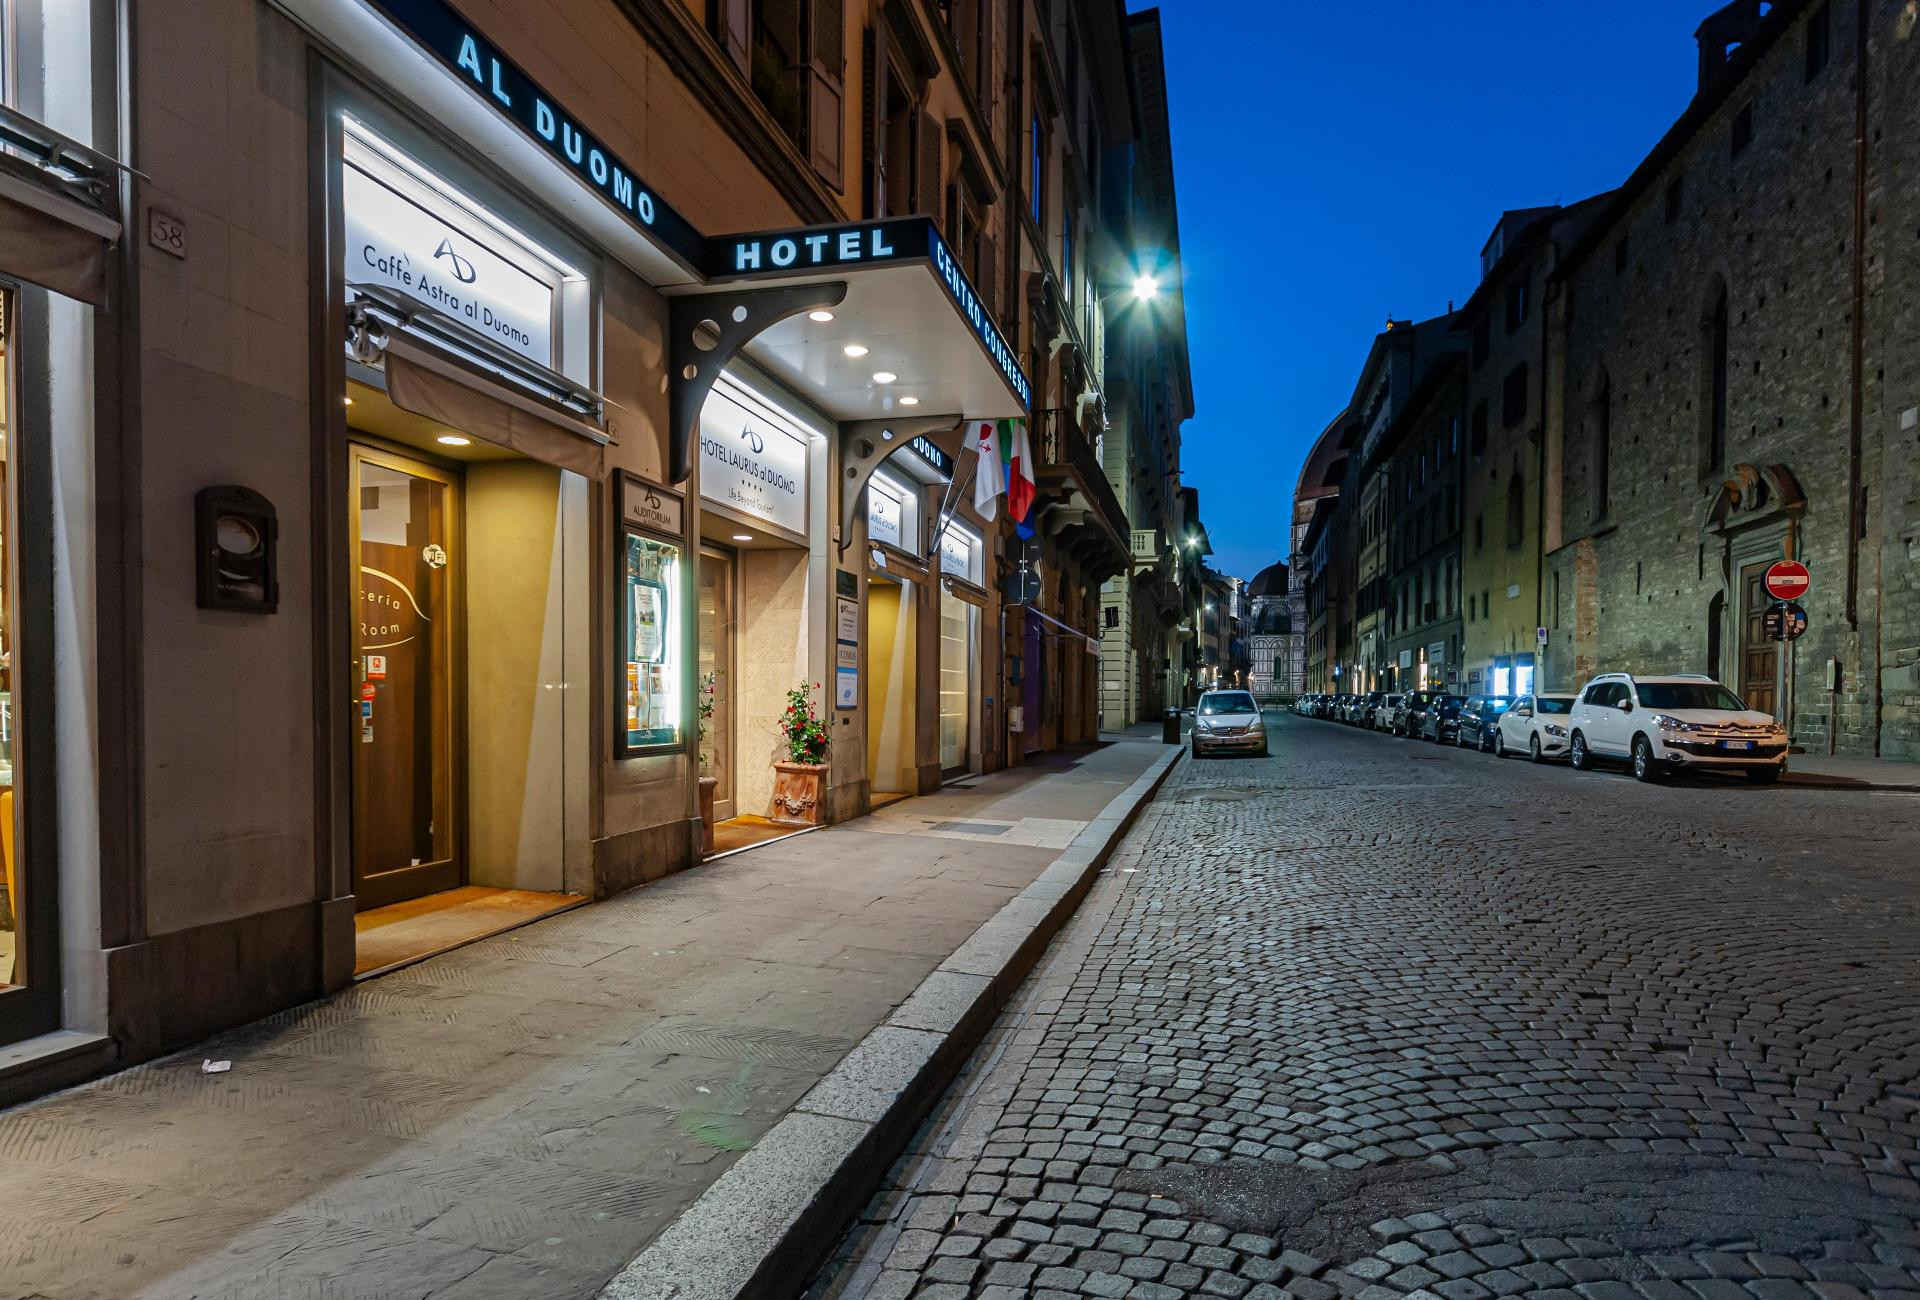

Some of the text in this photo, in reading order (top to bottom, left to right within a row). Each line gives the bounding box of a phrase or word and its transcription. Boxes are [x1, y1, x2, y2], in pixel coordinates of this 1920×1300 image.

[457, 33, 655, 225] AL DUOMO
[153, 220, 183, 249] 58
[735, 229, 893, 271] HOTEL
[363, 244, 530, 346] Caffè Astra al Duomo
[937, 241, 1028, 404] CENTRO CONGRESSI
[700, 435, 795, 495] HOTEL LAURUS al DUOMO
[633, 504, 671, 527] AUDITORIUM
